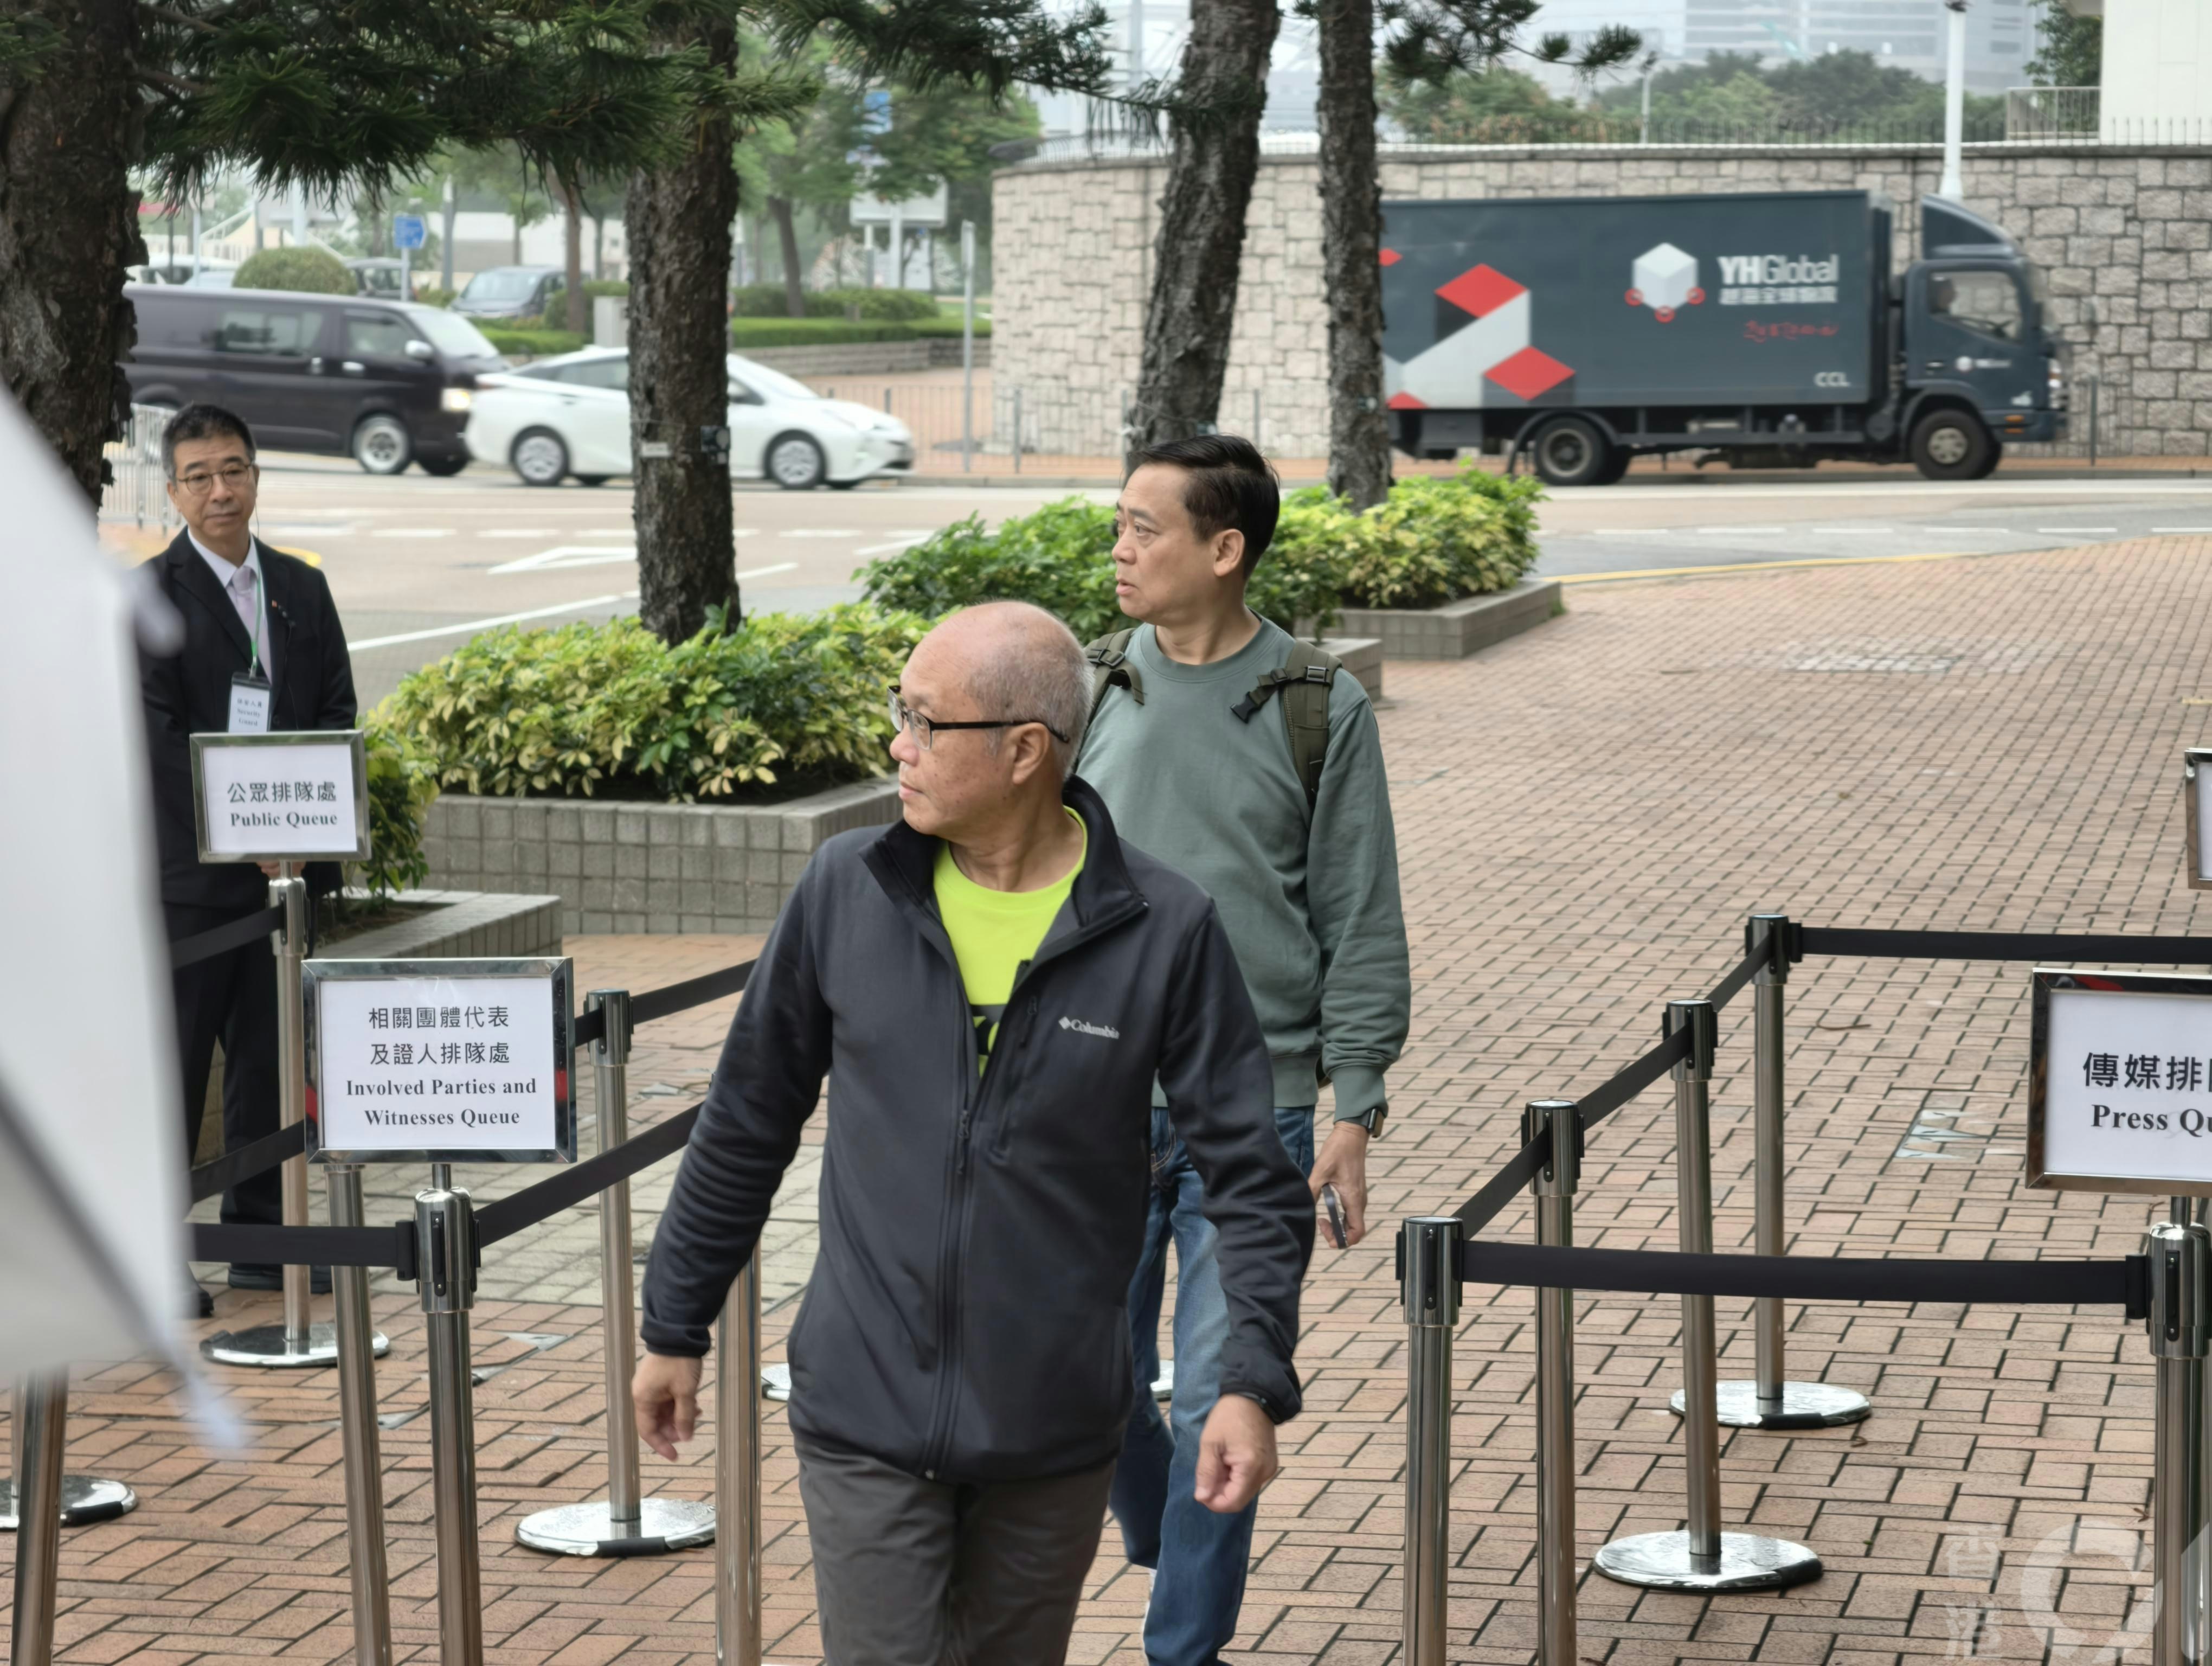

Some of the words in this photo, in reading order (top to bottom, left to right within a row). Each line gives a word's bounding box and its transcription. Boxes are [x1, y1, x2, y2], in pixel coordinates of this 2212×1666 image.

[1814, 371, 1850, 387] CCL
[227, 781, 337, 803] 公眾排隊處
[230, 812, 281, 827] Public
[286, 812, 338, 829] Queue
[368, 1005, 509, 1029] 相關團體代表
[1071, 1019, 1120, 1039] Columbia
[370, 1042, 510, 1065] 及證人排隊處
[2082, 1052, 2212, 1093] 傳媒排
[346, 1080, 425, 1095] Involved
[432, 1079, 496, 1094] Parties
[503, 1078, 537, 1094] and
[364, 1109, 454, 1126] Witnesses
[460, 1108, 520, 1128] Queue
[2091, 1104, 2169, 1131] Press
